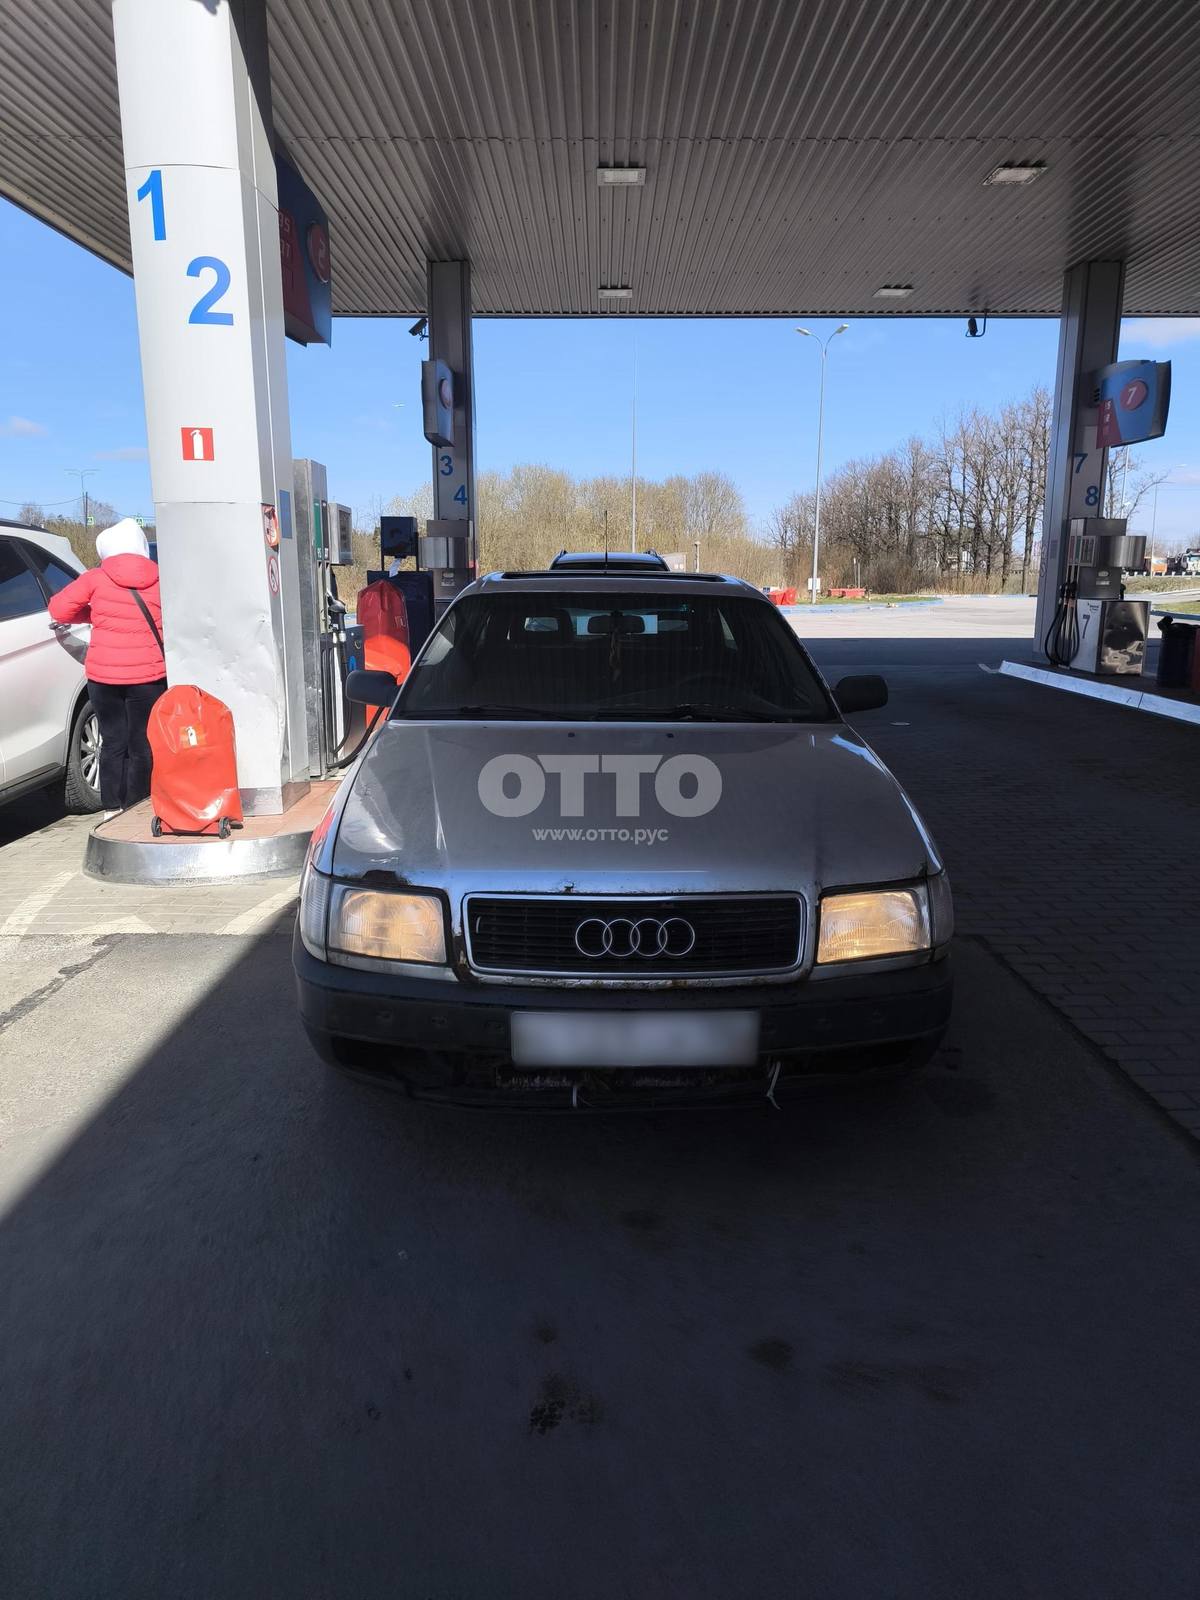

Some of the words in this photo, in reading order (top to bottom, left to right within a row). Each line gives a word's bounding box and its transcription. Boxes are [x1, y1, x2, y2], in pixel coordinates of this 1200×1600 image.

[137, 170, 167, 241] 1
[186, 256, 234, 326] 2
[1127, 386, 1138, 405] 7
[440, 455, 453, 476] 3
[1074, 453, 1088, 474] 7
[453, 484, 468, 505] 4
[1085, 485, 1099, 506] 8
[1082, 614, 1091, 640] 7
